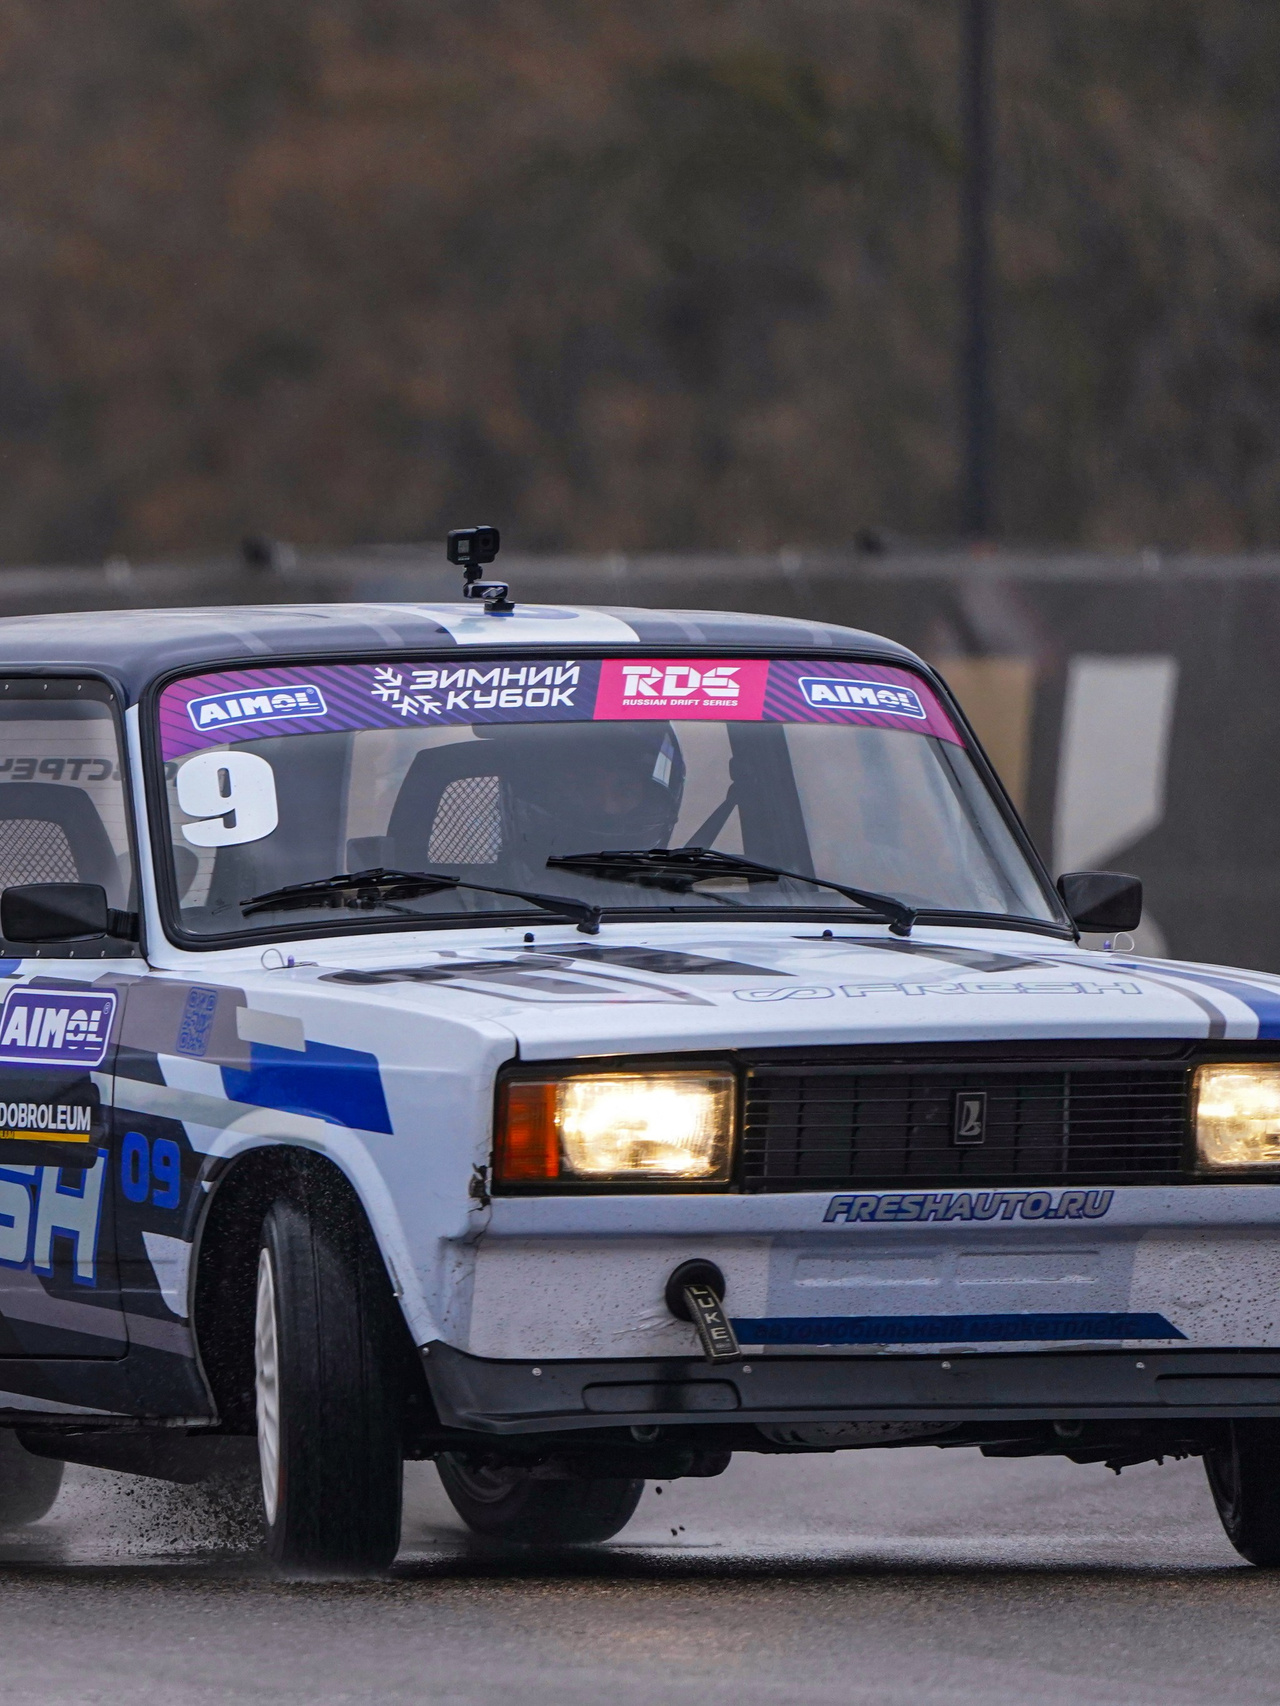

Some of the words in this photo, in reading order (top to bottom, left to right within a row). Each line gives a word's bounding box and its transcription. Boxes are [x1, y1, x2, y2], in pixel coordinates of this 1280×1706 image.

[410, 661, 580, 690] ЗИМНИЙ
[622, 665, 742, 697] RDS
[198, 690, 320, 726] AIMOL
[446, 689, 578, 710] КУБОК
[622, 699, 668, 707] RUSSIAN
[670, 699, 700, 707] DRIFT
[702, 700, 739, 708] SERIES
[809, 682, 920, 716] AIMOL
[177, 751, 279, 847] 9
[1, 1006, 104, 1050] AIMOL
[122, 1131, 181, 1210] 09
[823, 1189, 1113, 1223] FRESHAUTO.RU
[689, 1286, 729, 1340] LUKE
